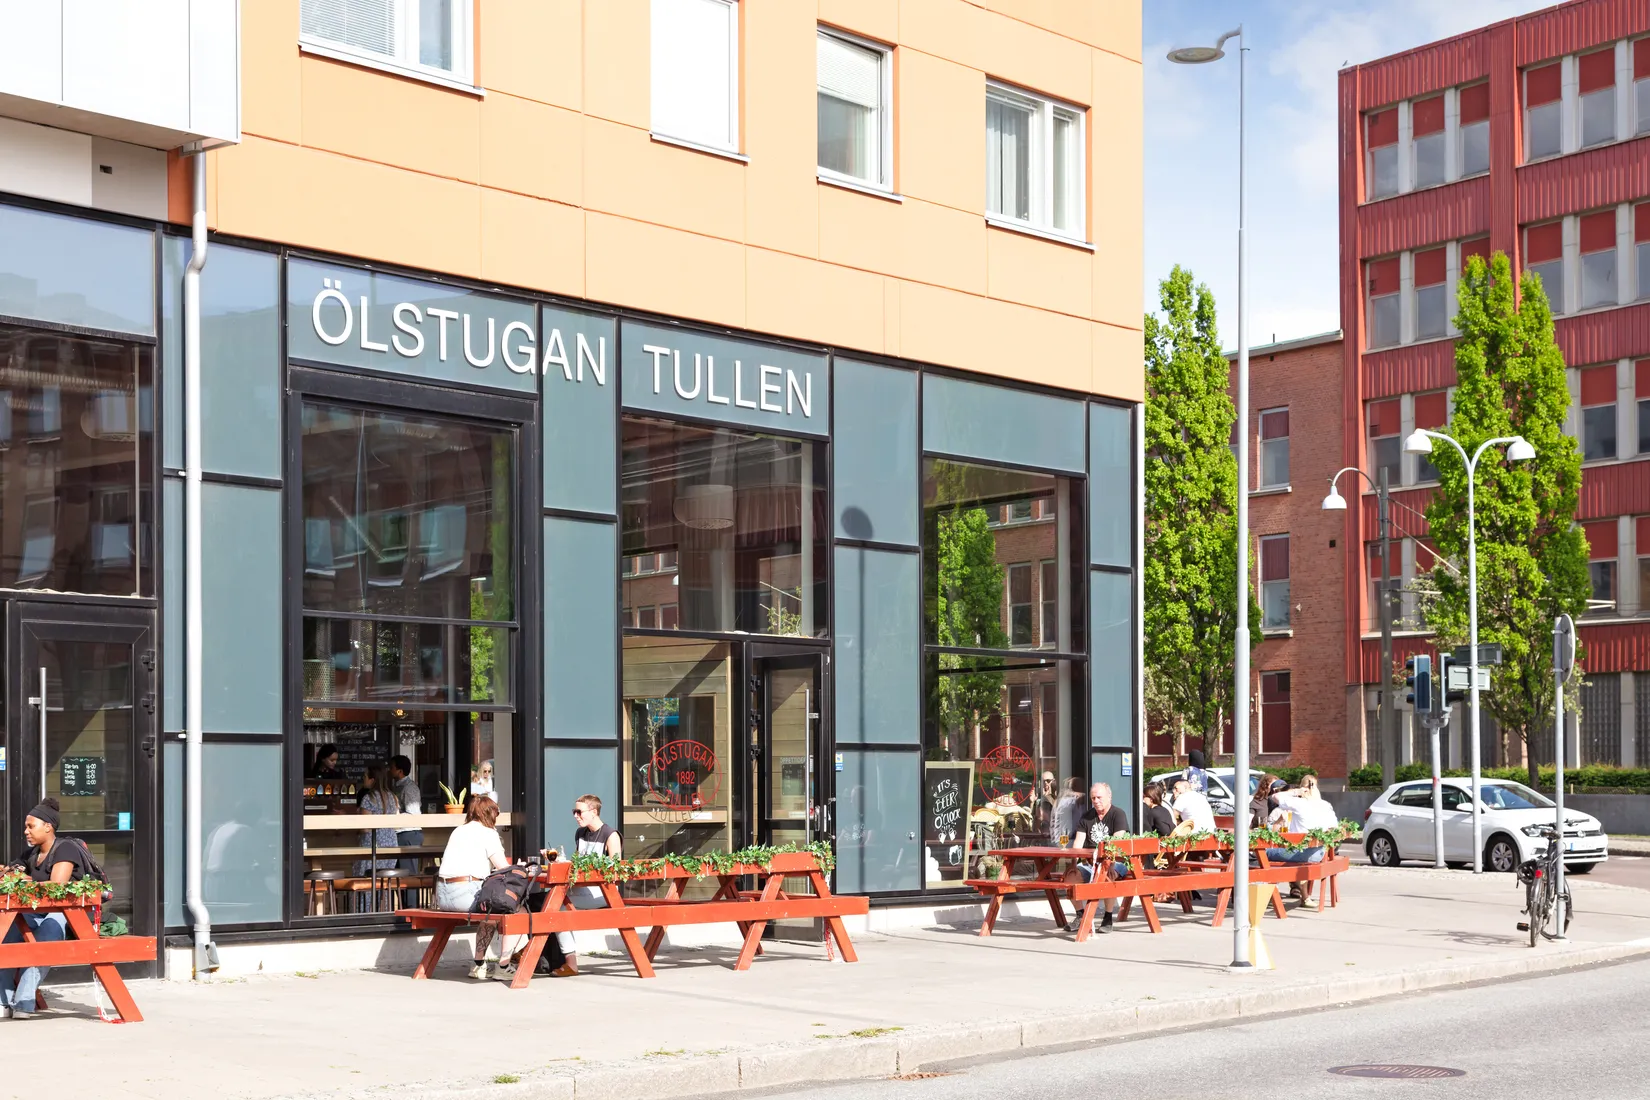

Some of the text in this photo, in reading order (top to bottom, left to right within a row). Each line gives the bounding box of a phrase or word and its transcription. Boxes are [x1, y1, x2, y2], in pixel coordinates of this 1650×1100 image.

[312, 278, 812, 418] ÖLSTUGAN TULLEN
[655, 743, 715, 772] ÖLSTUGAN
[676, 771, 696, 785] 1892
[935, 791, 956, 813] BEER
